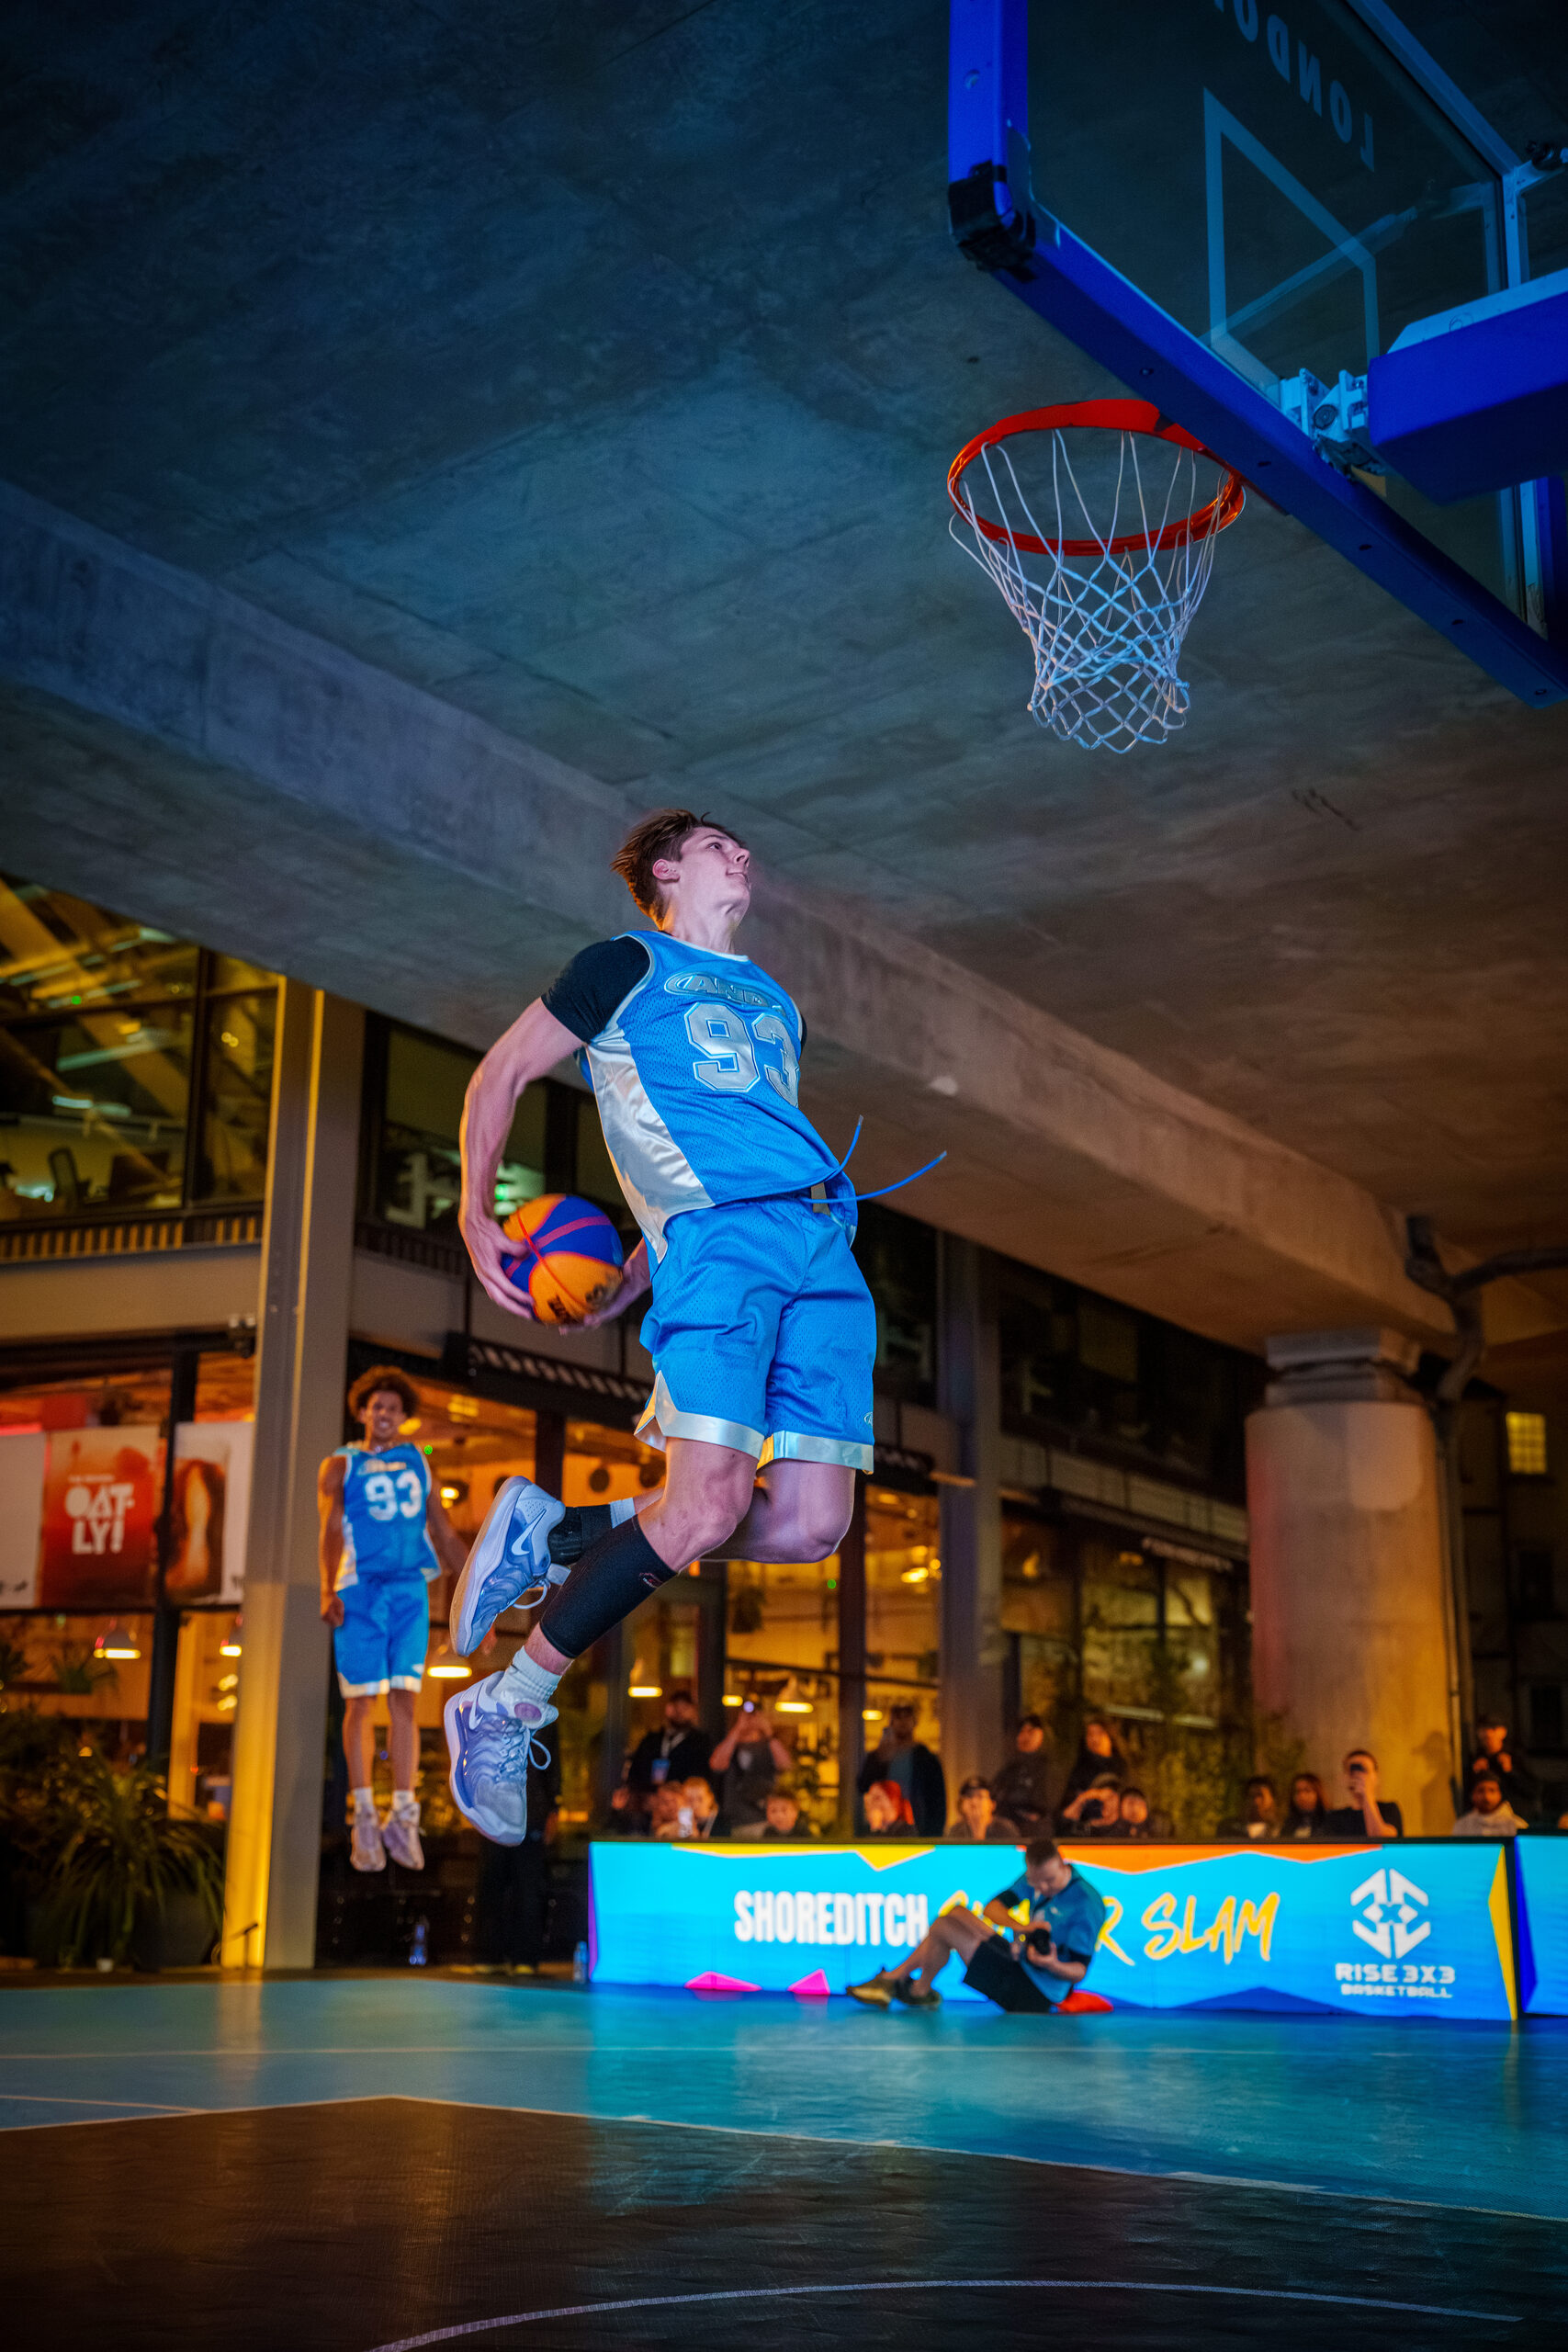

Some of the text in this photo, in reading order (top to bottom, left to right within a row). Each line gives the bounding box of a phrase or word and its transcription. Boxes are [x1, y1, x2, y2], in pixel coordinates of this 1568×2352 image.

[683, 1001, 799, 1108] 93
[364, 1471, 423, 1521] 93
[734, 1889, 929, 1949] SHOREDITCH
[1141, 1891, 1280, 1965] SLAM
[1335, 1962, 1456, 1984] RISE 3X3
[1340, 1983, 1453, 1998] BASKETBALL
